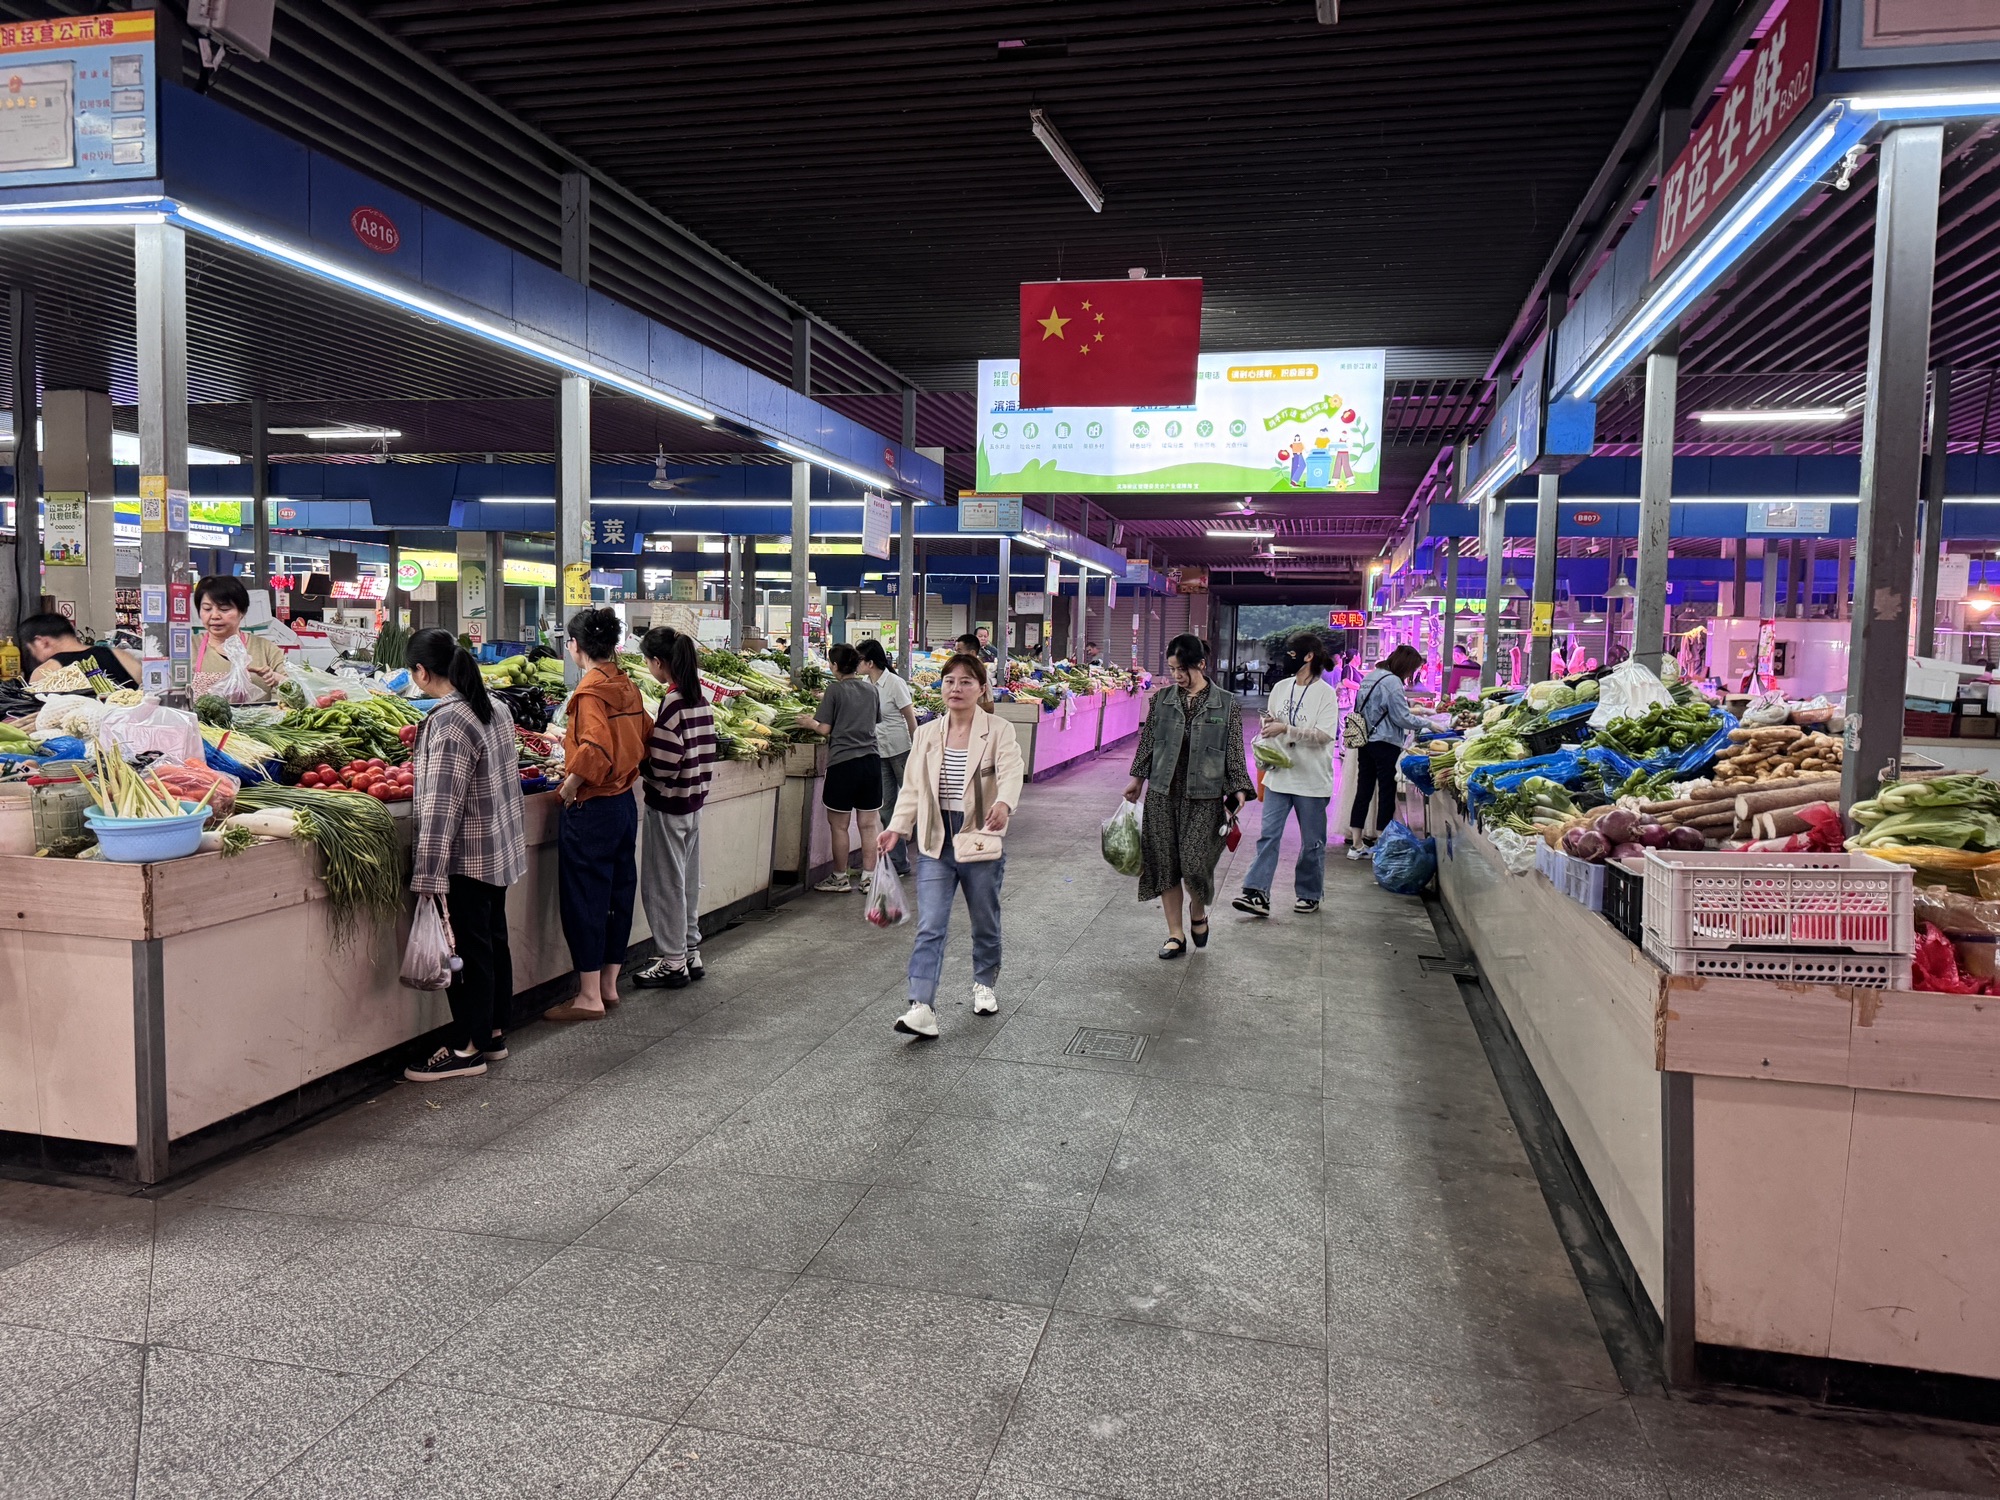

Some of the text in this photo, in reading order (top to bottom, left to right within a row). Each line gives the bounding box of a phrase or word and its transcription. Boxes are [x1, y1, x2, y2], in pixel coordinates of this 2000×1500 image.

[1656, 19, 1787, 262] 好运生鲜
[359, 216, 394, 244] A816
[1331, 612, 1364, 627] 鸡鸭
